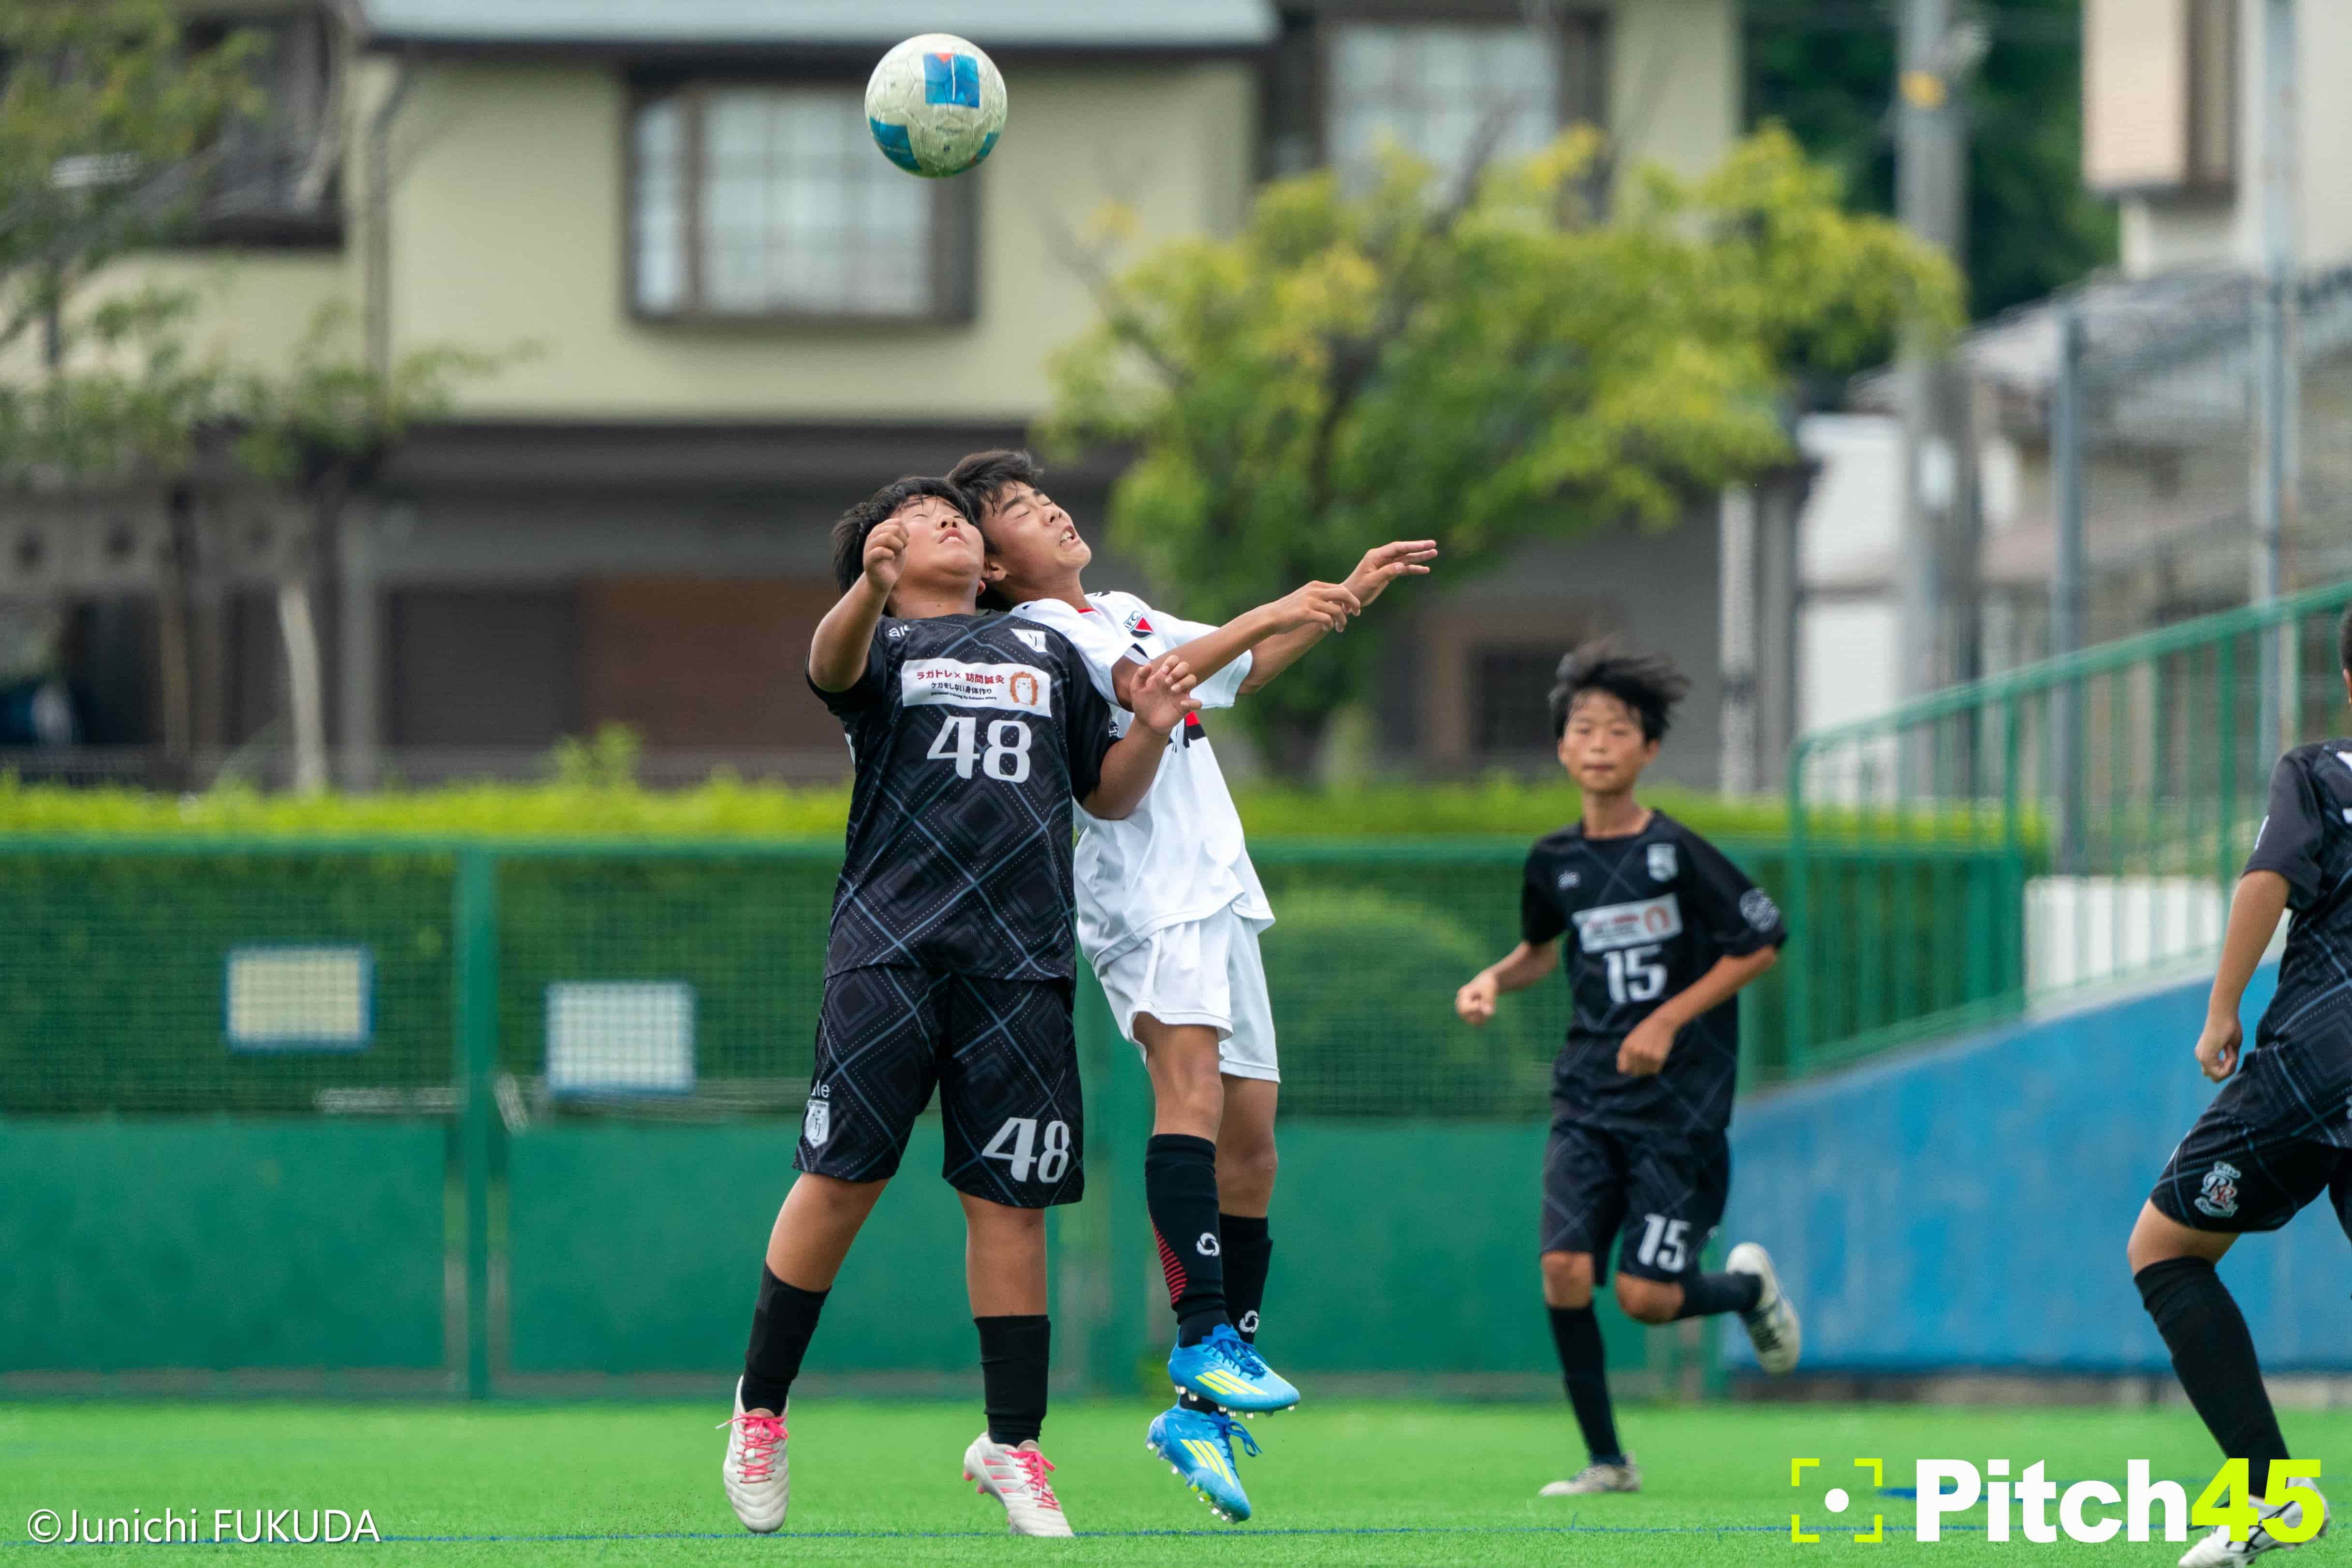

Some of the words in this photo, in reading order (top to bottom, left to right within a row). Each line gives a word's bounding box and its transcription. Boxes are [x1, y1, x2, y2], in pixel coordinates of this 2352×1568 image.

[931, 682, 992, 695] ケガをしない身体作り
[927, 716, 1032, 783] 48
[1603, 943, 1667, 1003] 15
[982, 1117, 1070, 1184] 48
[1637, 1213, 1691, 1273] 15
